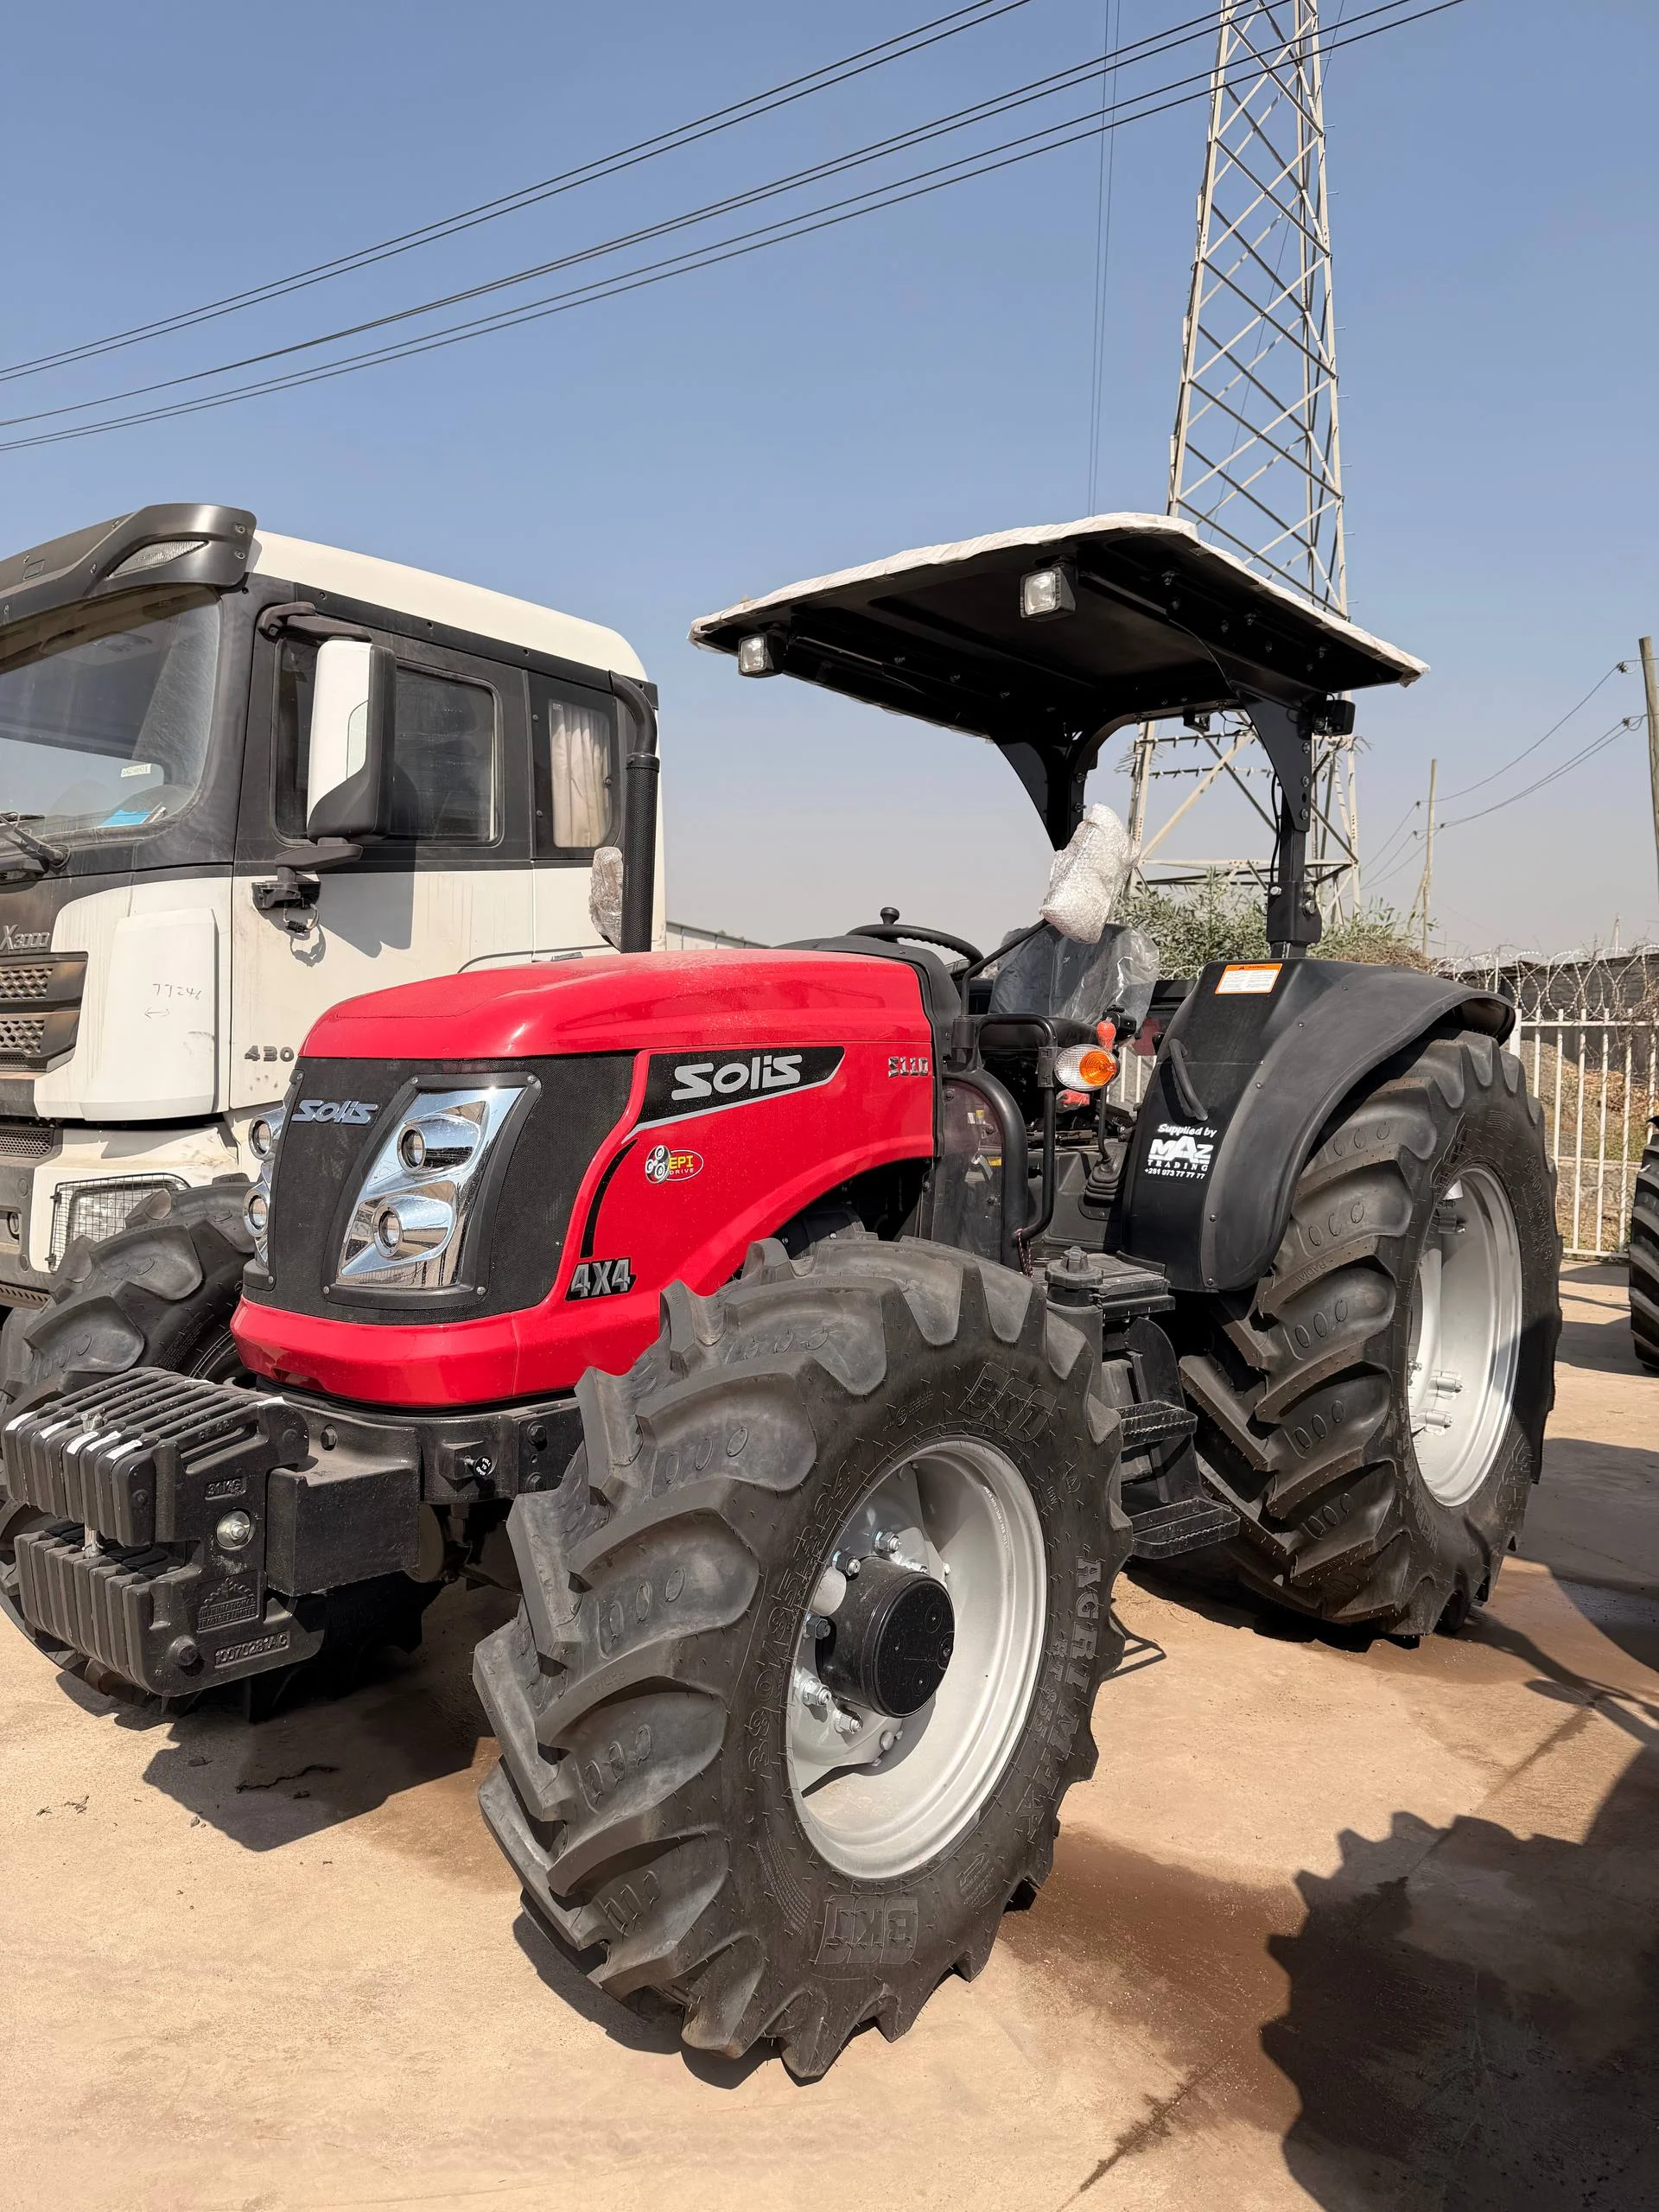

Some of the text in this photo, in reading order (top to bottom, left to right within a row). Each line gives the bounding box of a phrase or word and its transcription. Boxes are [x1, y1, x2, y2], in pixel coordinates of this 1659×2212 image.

[0, 924, 50, 950] X3000
[244, 1046, 295, 1062] 430
[888, 1056, 929, 1078] S110
[1158, 1123, 1217, 1138] Supplied by
[1148, 1135, 1214, 1165] MAZ
[669, 1155, 693, 1169] EPI
[1147, 1159, 1209, 1172] TRADING
